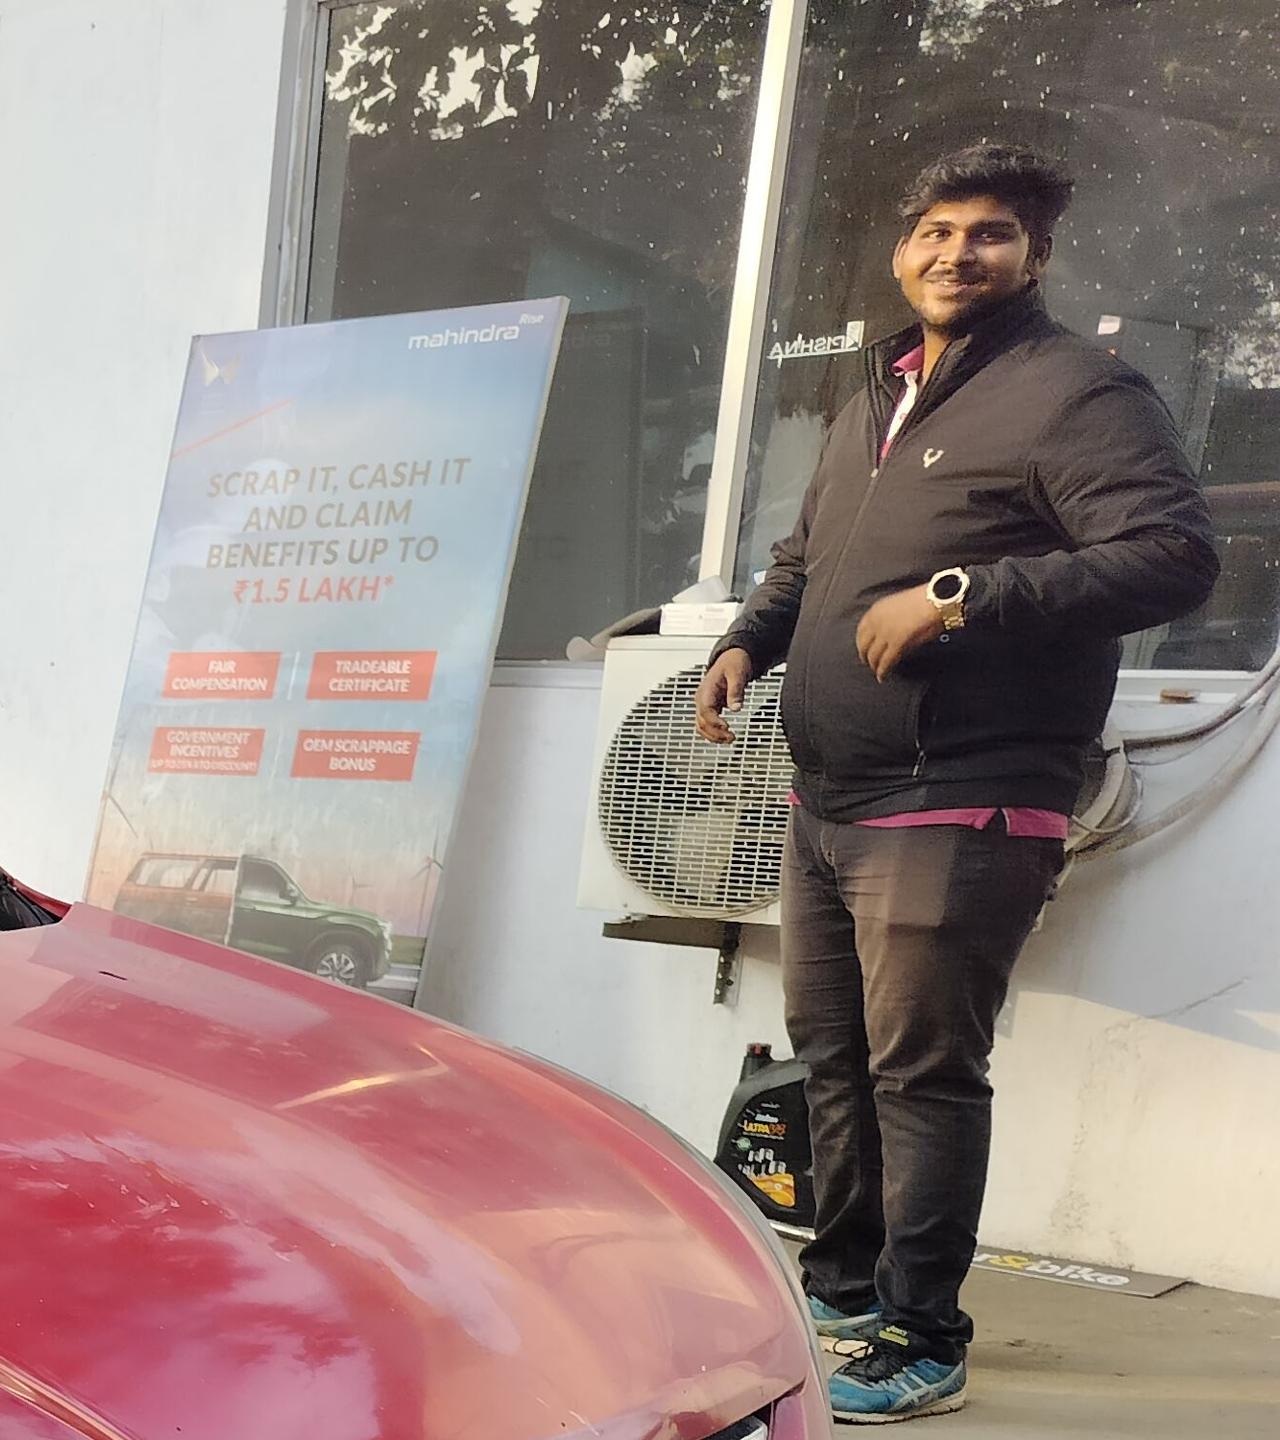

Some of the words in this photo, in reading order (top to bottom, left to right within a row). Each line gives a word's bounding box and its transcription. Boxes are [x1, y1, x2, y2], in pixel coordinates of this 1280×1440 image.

[408, 324, 520, 350] mahindra
[206, 469, 301, 498] SCRAP
[307, 467, 339, 495] IT,
[348, 460, 432, 490] CASH
[441, 458, 471, 485] IT
[243, 504, 308, 532] AND
[315, 499, 412, 529] CLAIM
[206, 540, 339, 568] BENEFITS
[347, 538, 388, 565] UP
[398, 536, 439, 562] TO
[233, 578, 290, 604] ₹1.5
[208, 660, 237, 674] FAIR
[335, 660, 412, 674] TRADEABLE
[171, 678, 268, 691] COMPENSATION
[328, 679, 411, 693] CERTIFICATE
[167, 731, 251, 745] GOVERNMENT
[170, 745, 240, 758] INCENTIVES
[303, 738, 334, 752] OEM
[335, 739, 412, 755] SCRAPPAGE
[329, 757, 377, 772] BONUS
[973, 1253, 1130, 1286] r&bike
